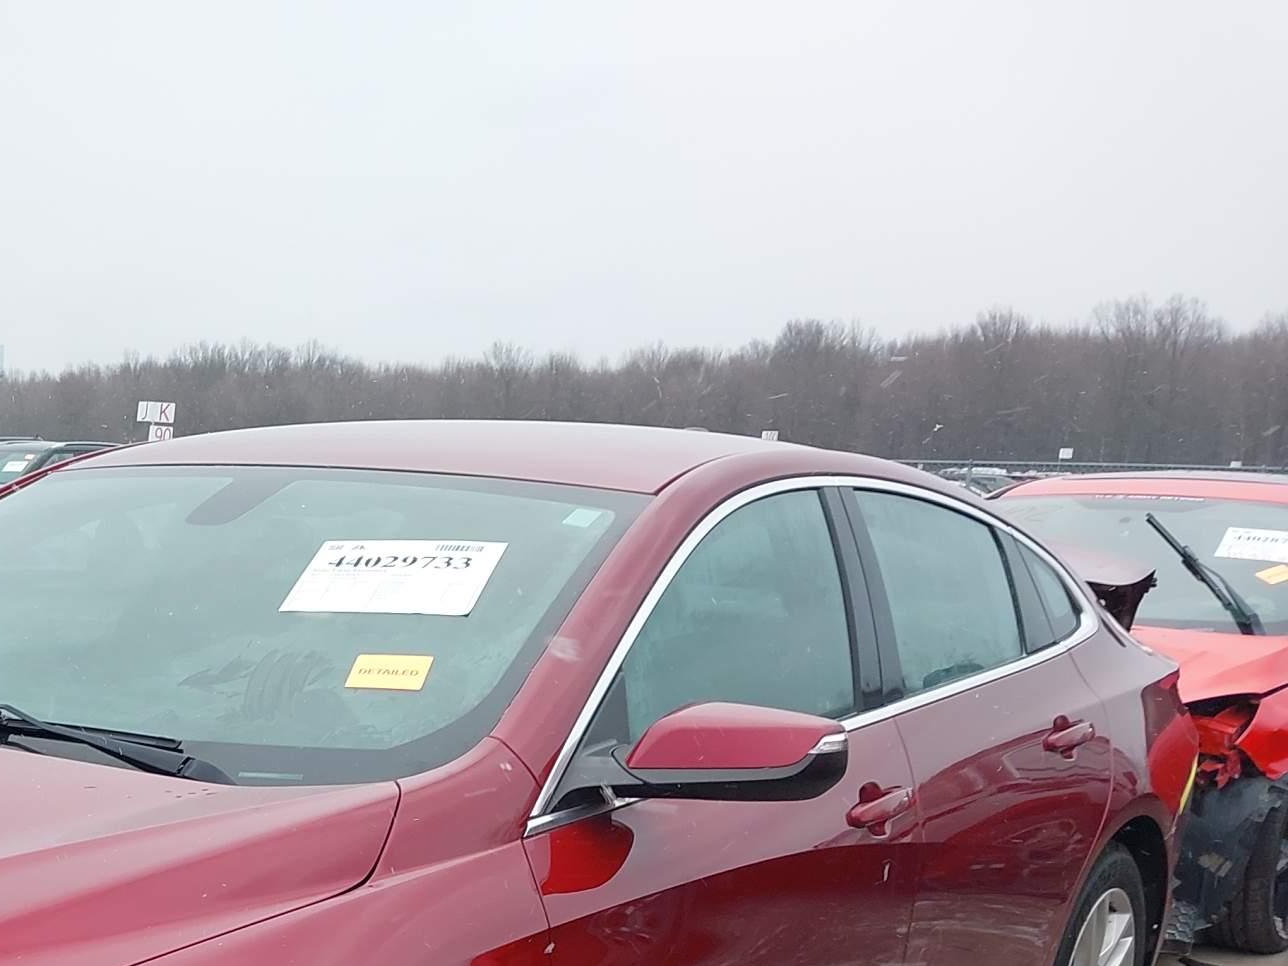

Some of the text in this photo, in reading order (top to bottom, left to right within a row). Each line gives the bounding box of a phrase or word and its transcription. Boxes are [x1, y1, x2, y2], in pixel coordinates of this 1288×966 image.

[159, 403, 171, 421] K
[155, 427, 172, 441] 90
[328, 555, 473, 570] 44029733
[357, 667, 420, 677] DETAILED
